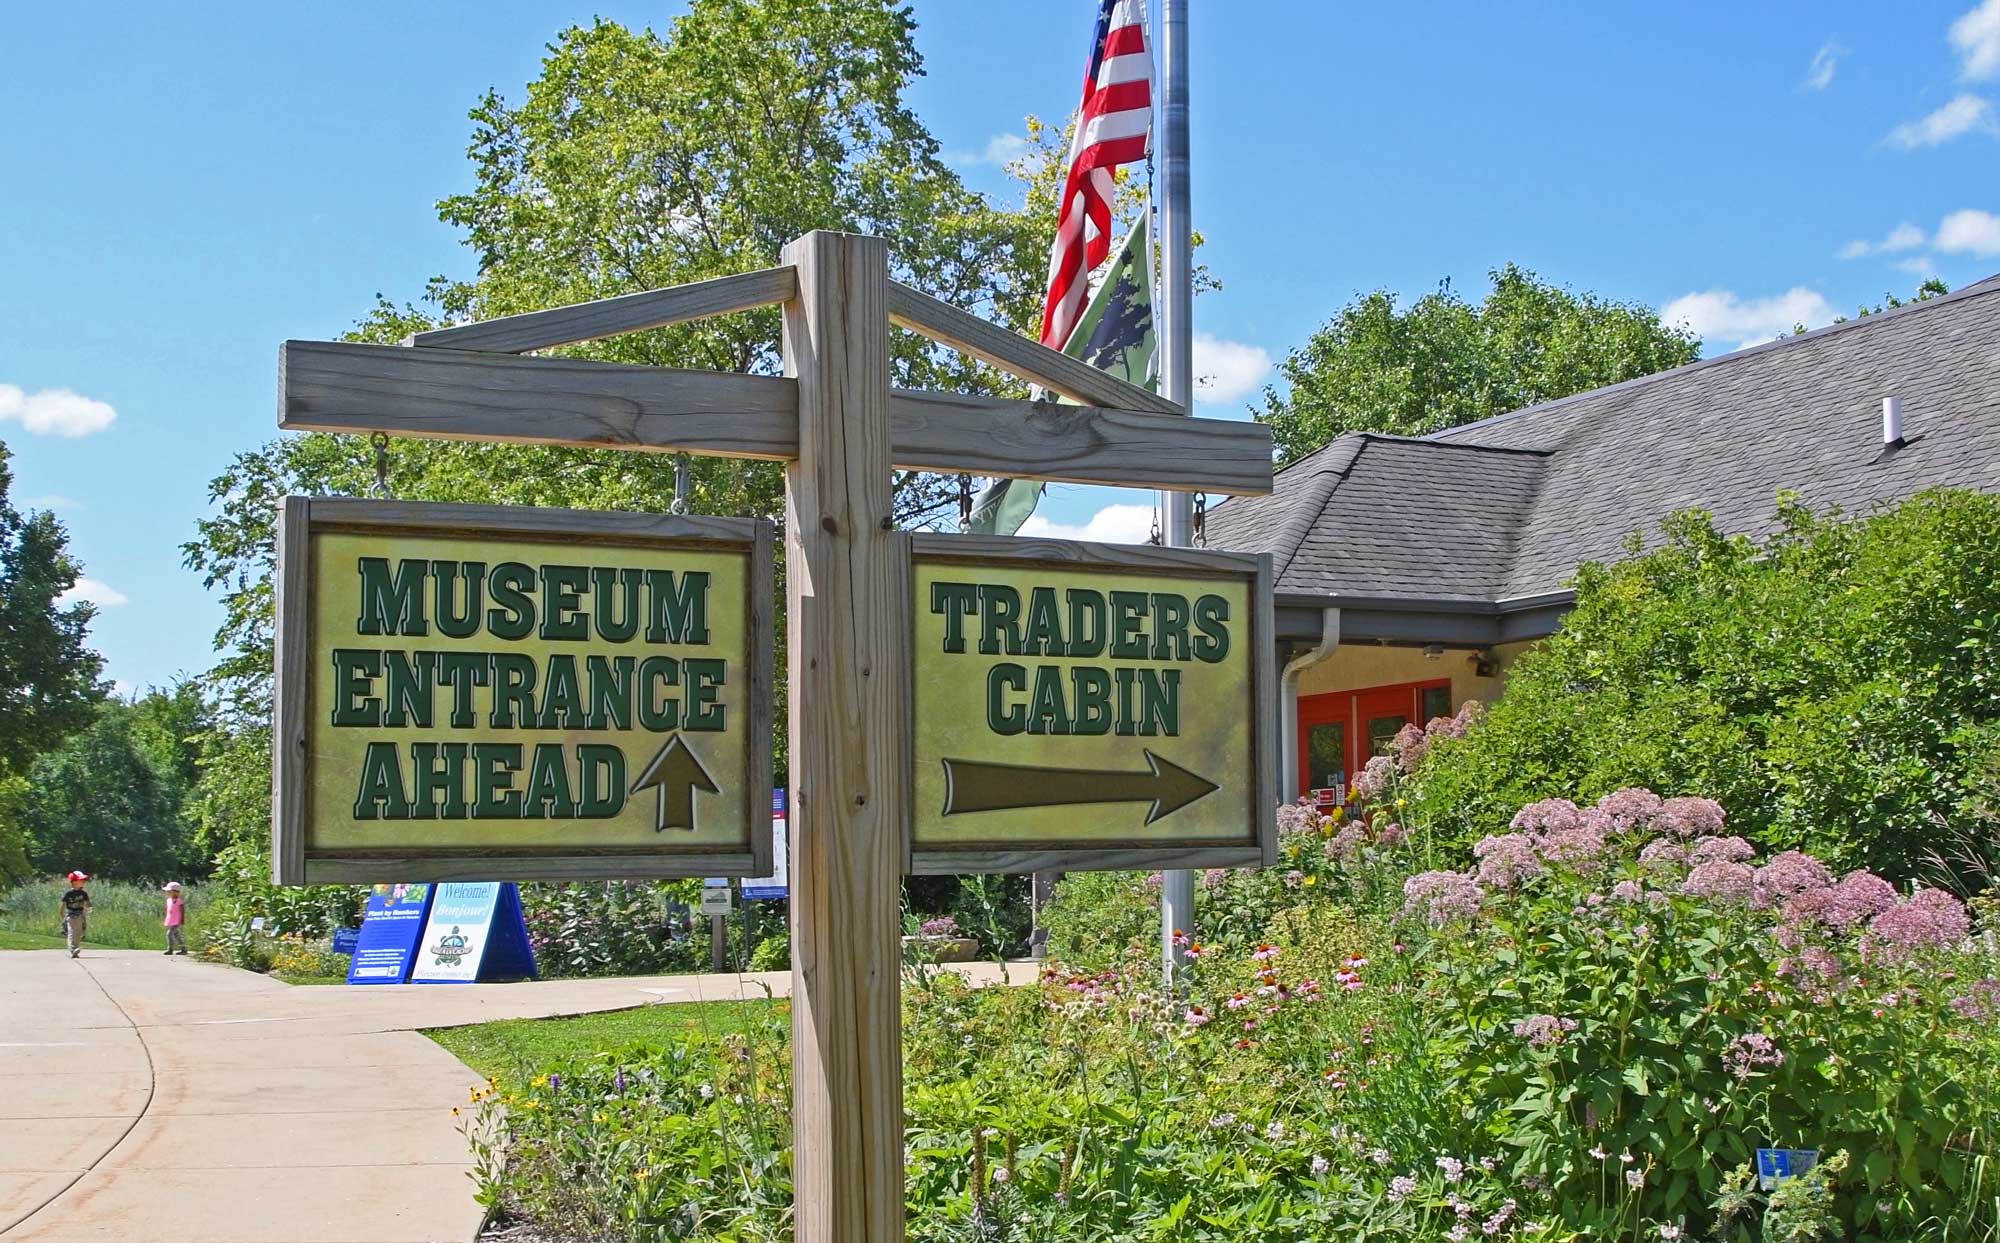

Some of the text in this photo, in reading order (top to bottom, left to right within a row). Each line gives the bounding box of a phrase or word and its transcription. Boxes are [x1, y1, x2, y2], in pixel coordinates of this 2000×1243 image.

[357, 556, 711, 645] MUSEUM
[930, 581, 1231, 664] TRADERS
[331, 648, 727, 733] ENTRANCE
[986, 662, 1183, 737] CABIN
[353, 741, 629, 820] AHEAD
[444, 883, 491, 899] Welcome!
